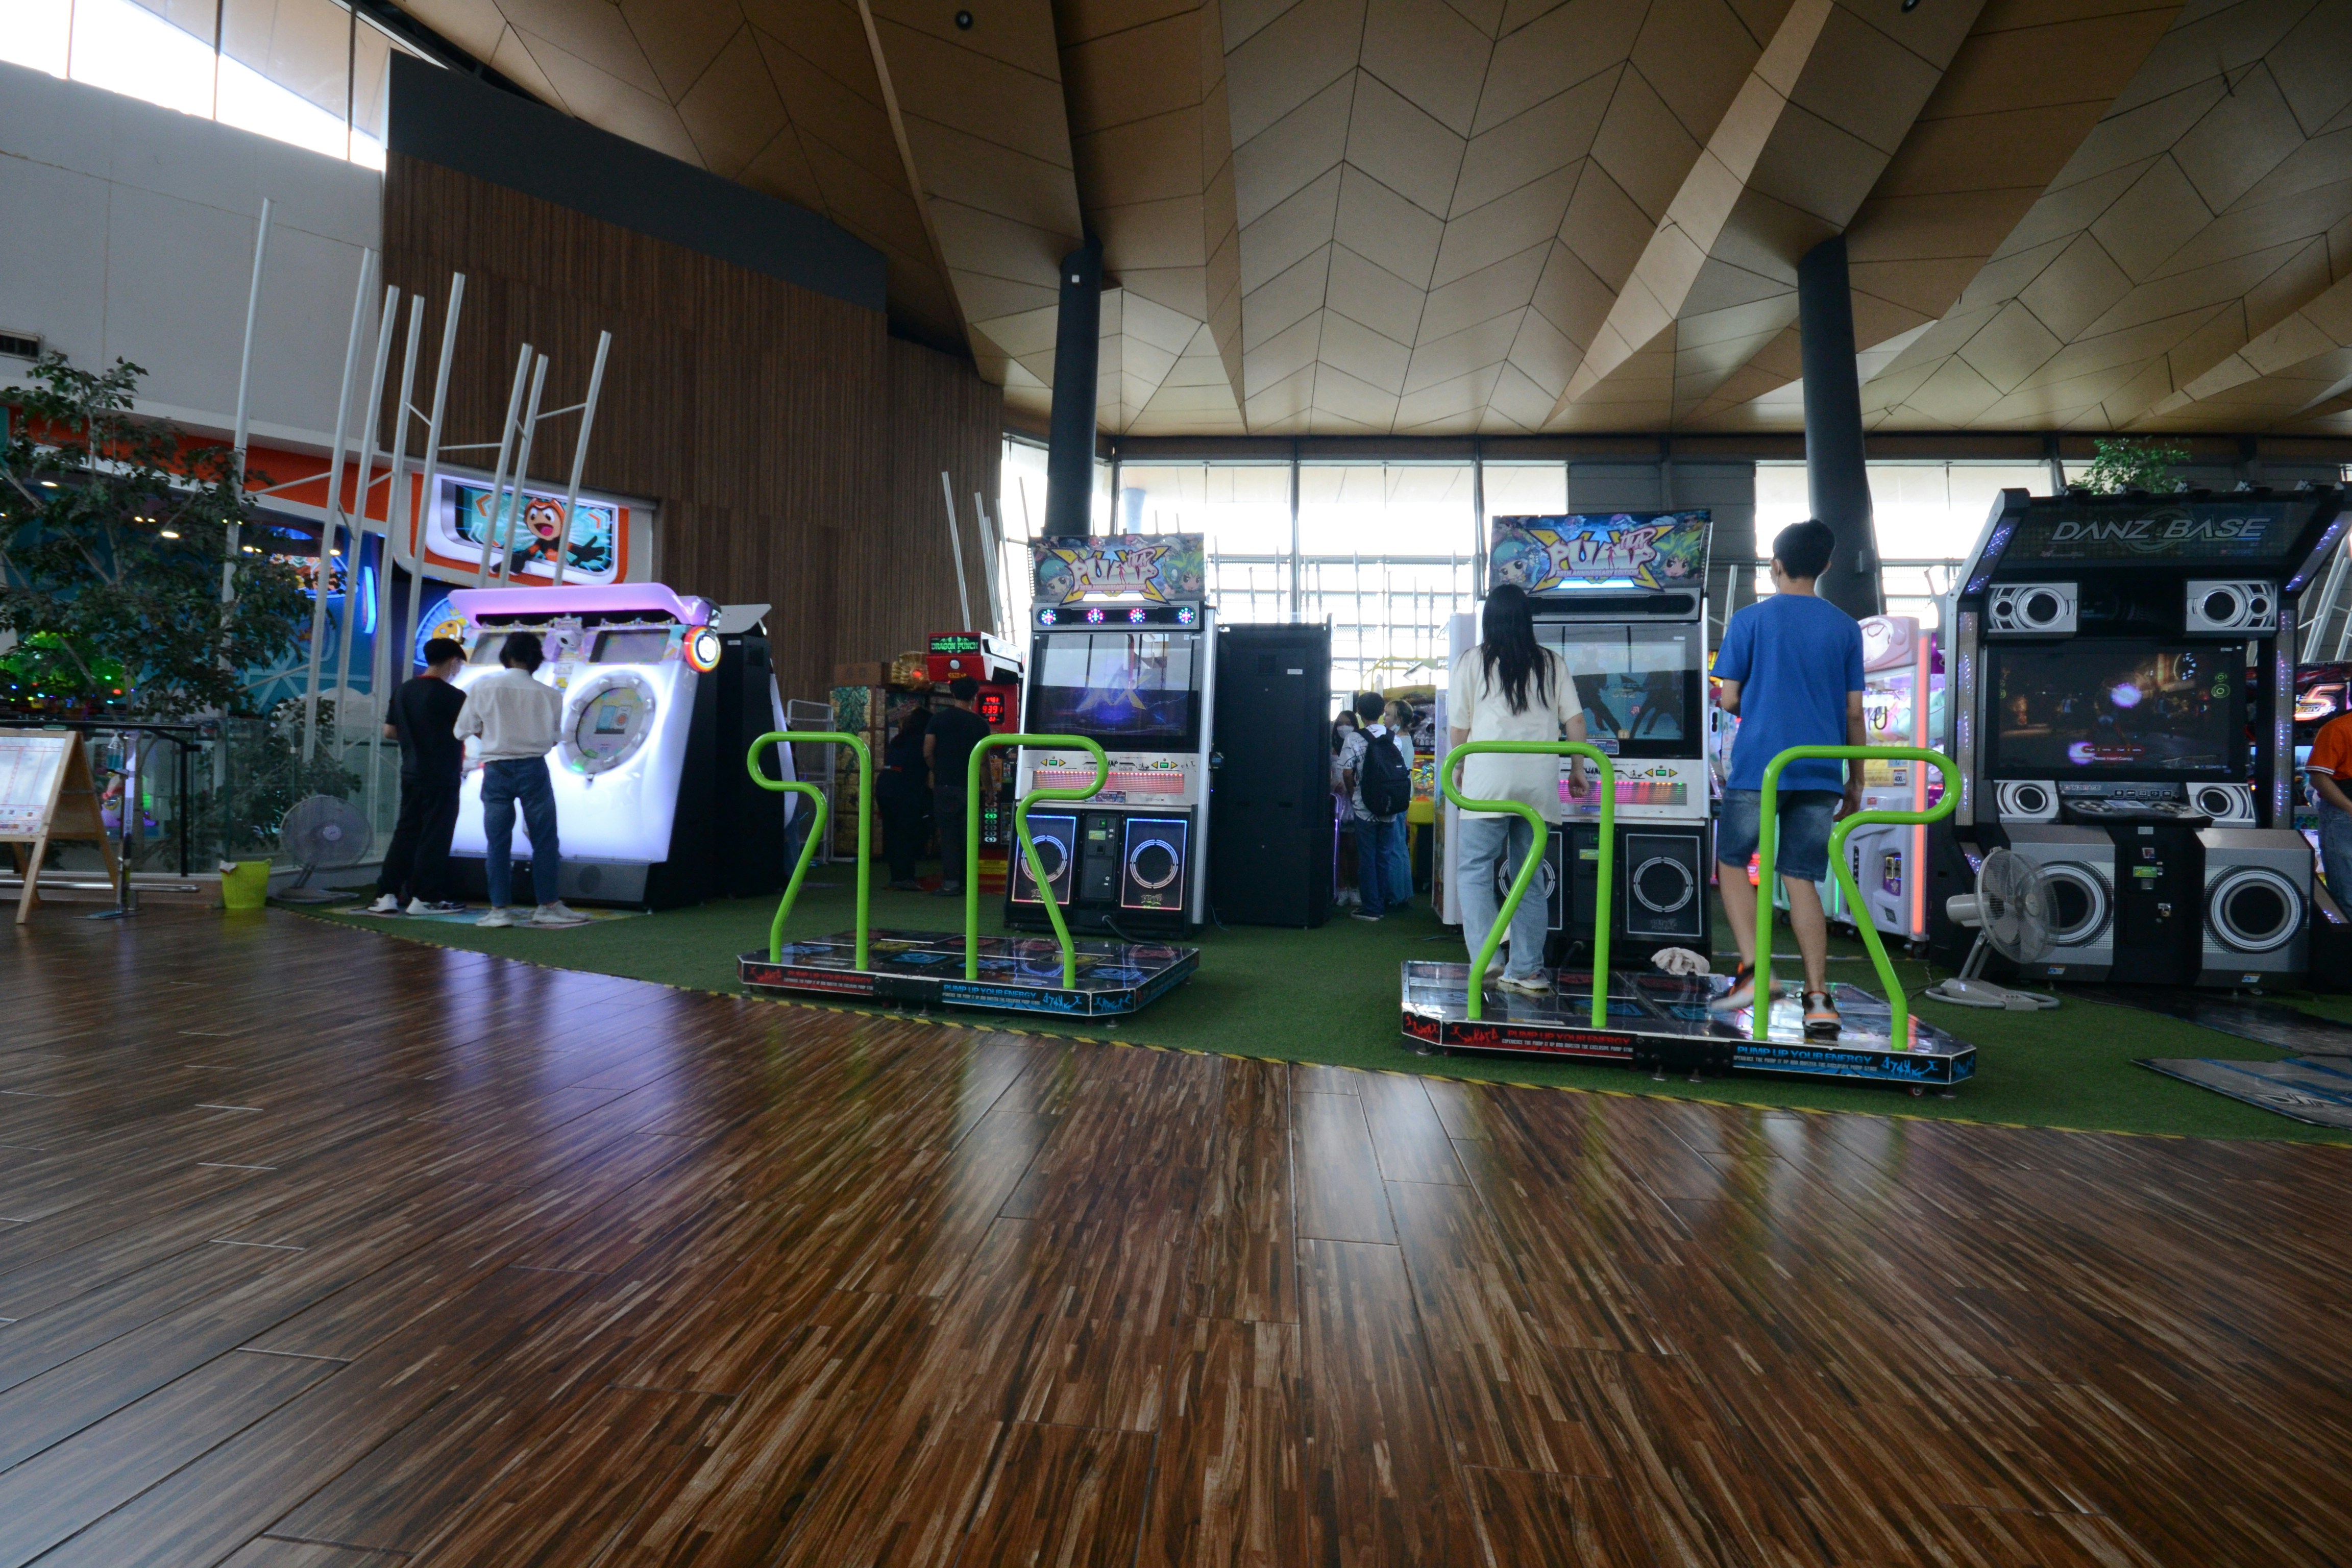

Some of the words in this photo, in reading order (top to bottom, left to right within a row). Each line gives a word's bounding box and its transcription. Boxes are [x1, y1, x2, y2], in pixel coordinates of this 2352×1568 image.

[2051, 520, 2157, 540] DANZ
[2162, 517, 2272, 539] BASE
[1544, 537, 1657, 579] PUMP
[1067, 557, 1159, 592] PUMP
[944, 984, 966, 993] PUMP
[980, 988, 1002, 996] YOUR
[1004, 989, 1036, 999] ENERGY
[1507, 1030, 1537, 1039] PUMP
[1539, 1032, 1555, 1040] UP
[1556, 1034, 1586, 1042] YOUR
[1587, 1035, 1630, 1045] ENERGY
[1737, 1046, 1770, 1056] PUMP
[1773, 1048, 1789, 1058] UP
[1791, 1050, 1823, 1061] YOUR
[1825, 1052, 1872, 1065] ENERGY
